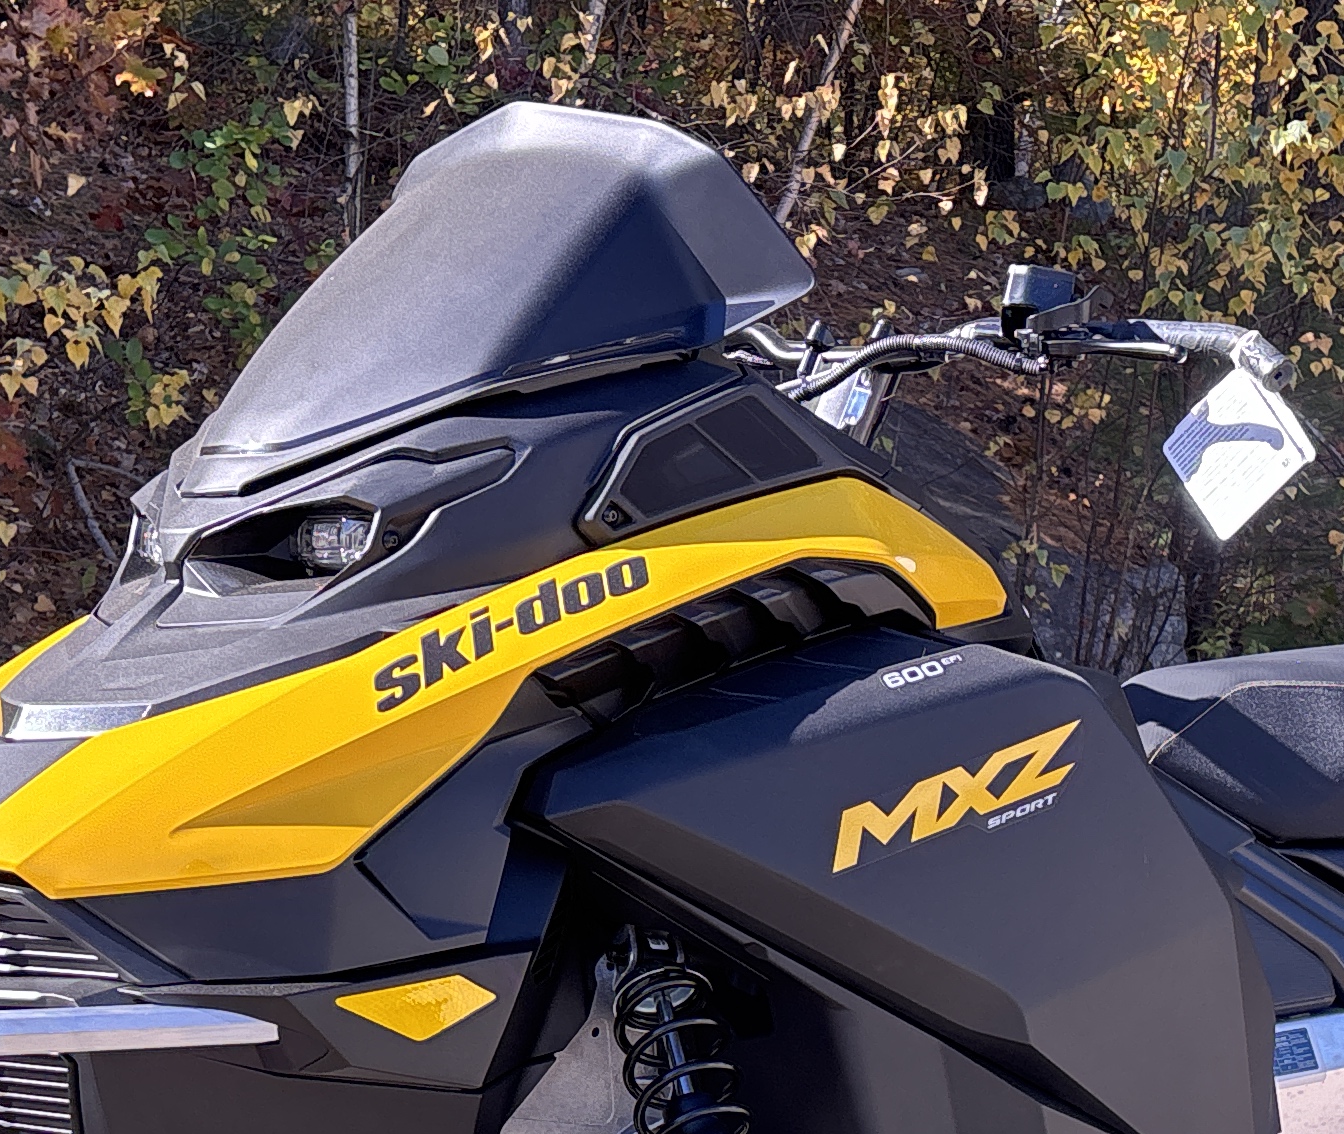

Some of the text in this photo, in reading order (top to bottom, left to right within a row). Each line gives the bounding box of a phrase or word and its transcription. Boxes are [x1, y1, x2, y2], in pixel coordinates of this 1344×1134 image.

[374, 556, 649, 713] ski-doo
[882, 660, 944, 689] 600
[832, 719, 1082, 874] MXZ
[987, 792, 1058, 829] SPORT
